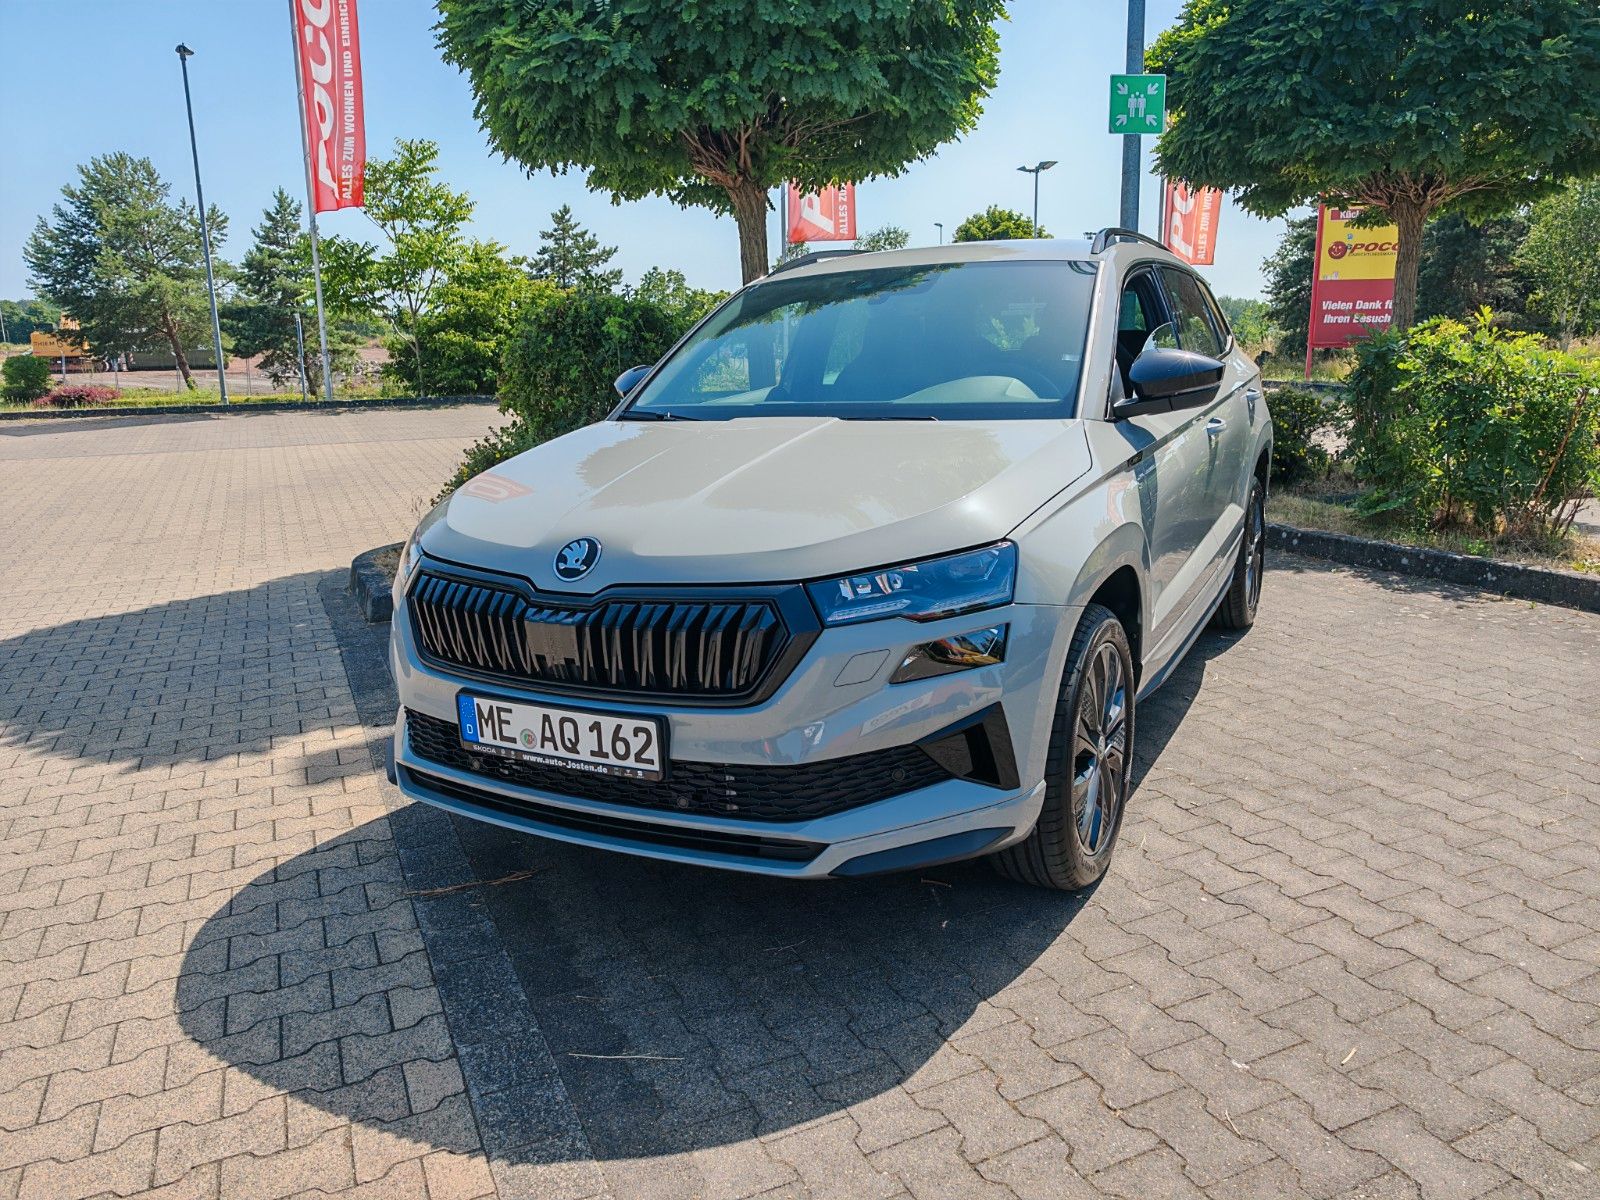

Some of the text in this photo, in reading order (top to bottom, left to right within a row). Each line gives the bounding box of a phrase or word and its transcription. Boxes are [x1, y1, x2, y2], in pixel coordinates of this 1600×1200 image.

[343, 52, 354, 79] UND
[344, 81, 355, 134] WOHNEN
[343, 138, 355, 164] ZUM
[341, 165, 353, 200] ALLES
[839, 205, 849, 235] ALLES
[1200, 212, 1211, 232] ZUM
[1197, 233, 1208, 260] ALLES
[1322, 301, 1353, 310] Vielen
[1356, 300, 1382, 310] Dank
[1324, 314, 1350, 323] Ihren
[466, 723, 474, 734] D
[476, 702, 655, 766] ME AQ 162
